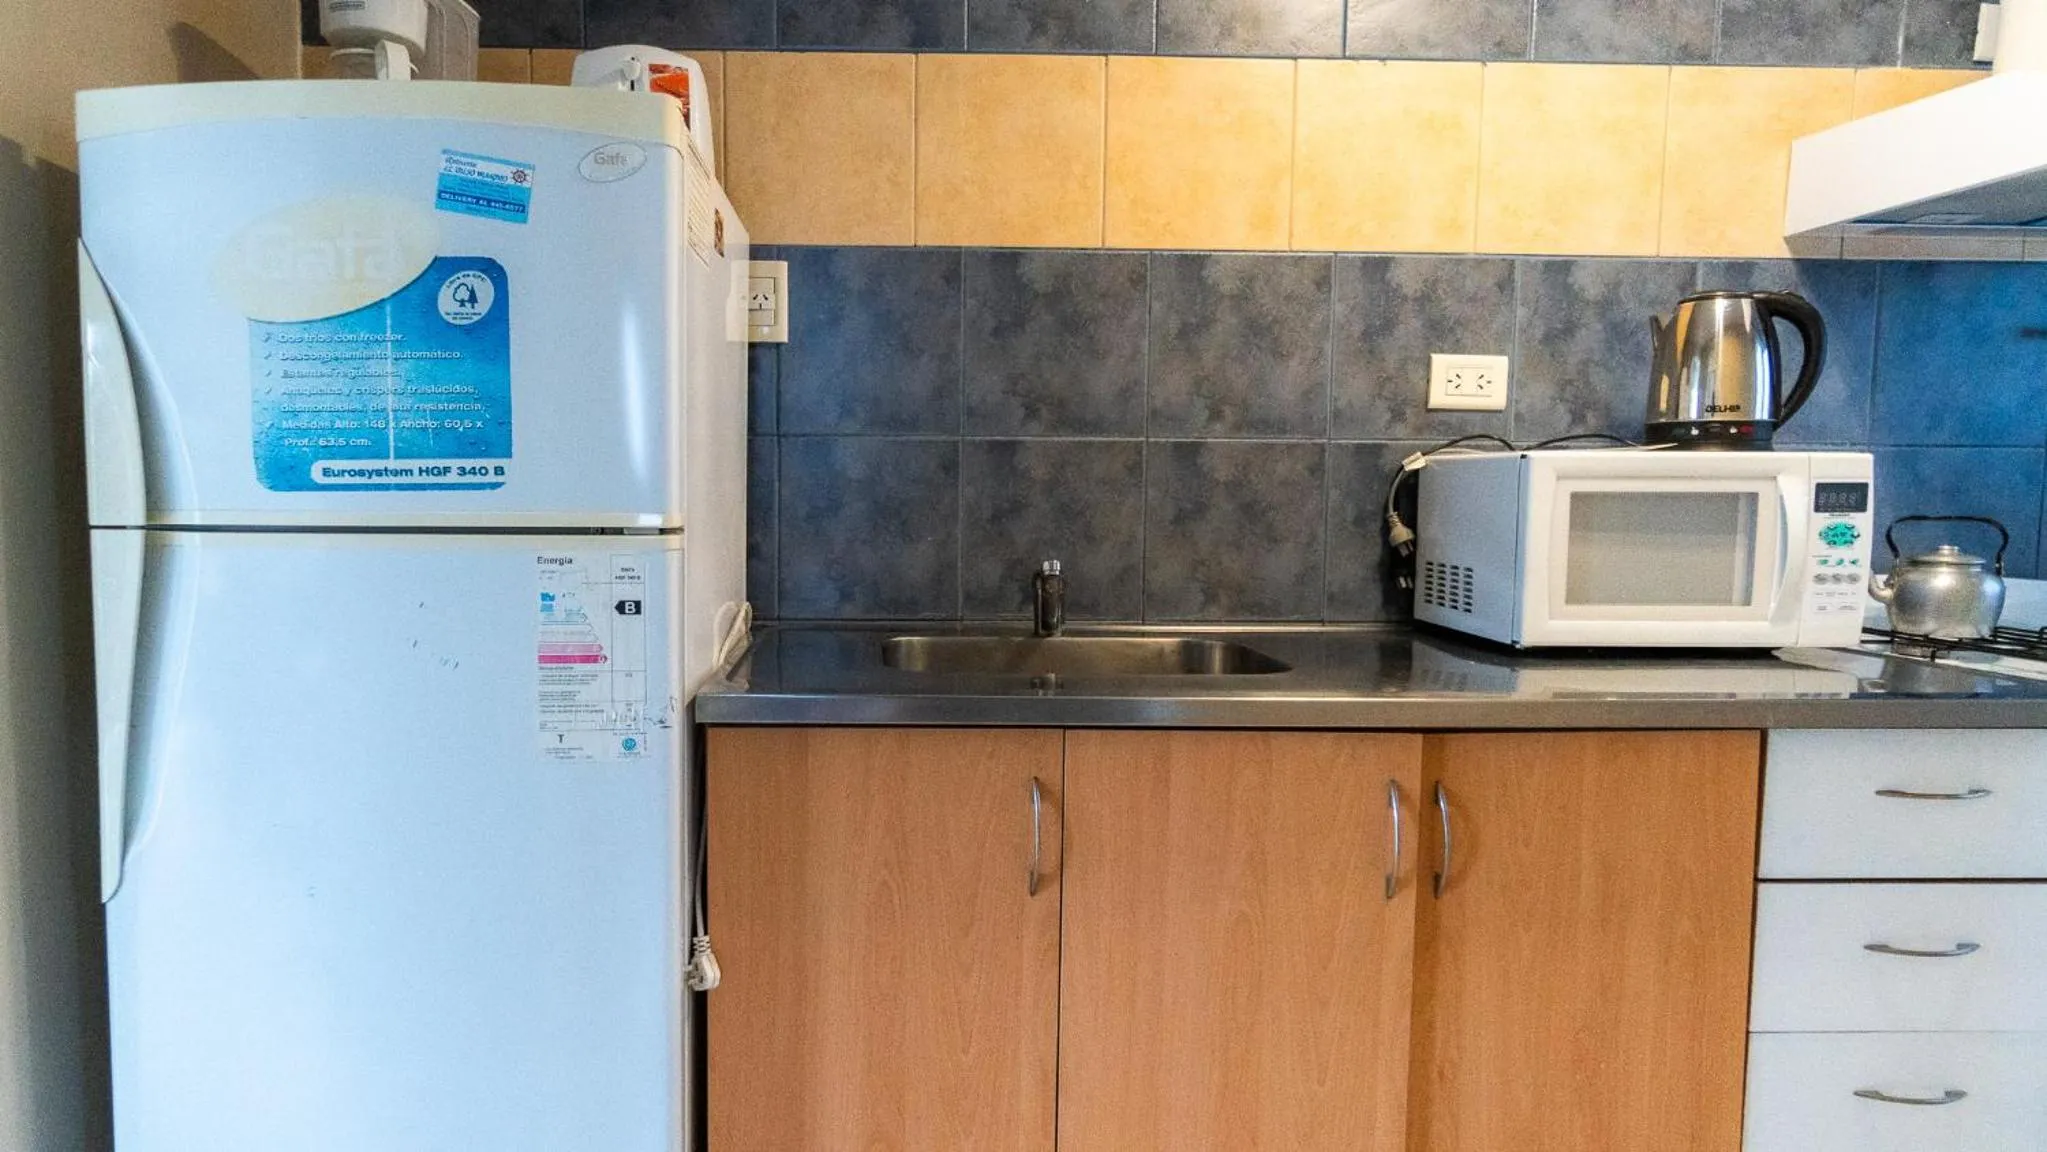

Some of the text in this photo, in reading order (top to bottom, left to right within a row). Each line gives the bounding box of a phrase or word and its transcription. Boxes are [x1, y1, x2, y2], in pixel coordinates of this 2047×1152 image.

[476, 420, 485, 429] x
[321, 465, 506, 480] Eurosystem HGF 340 B
[624, 601, 636, 614] B
